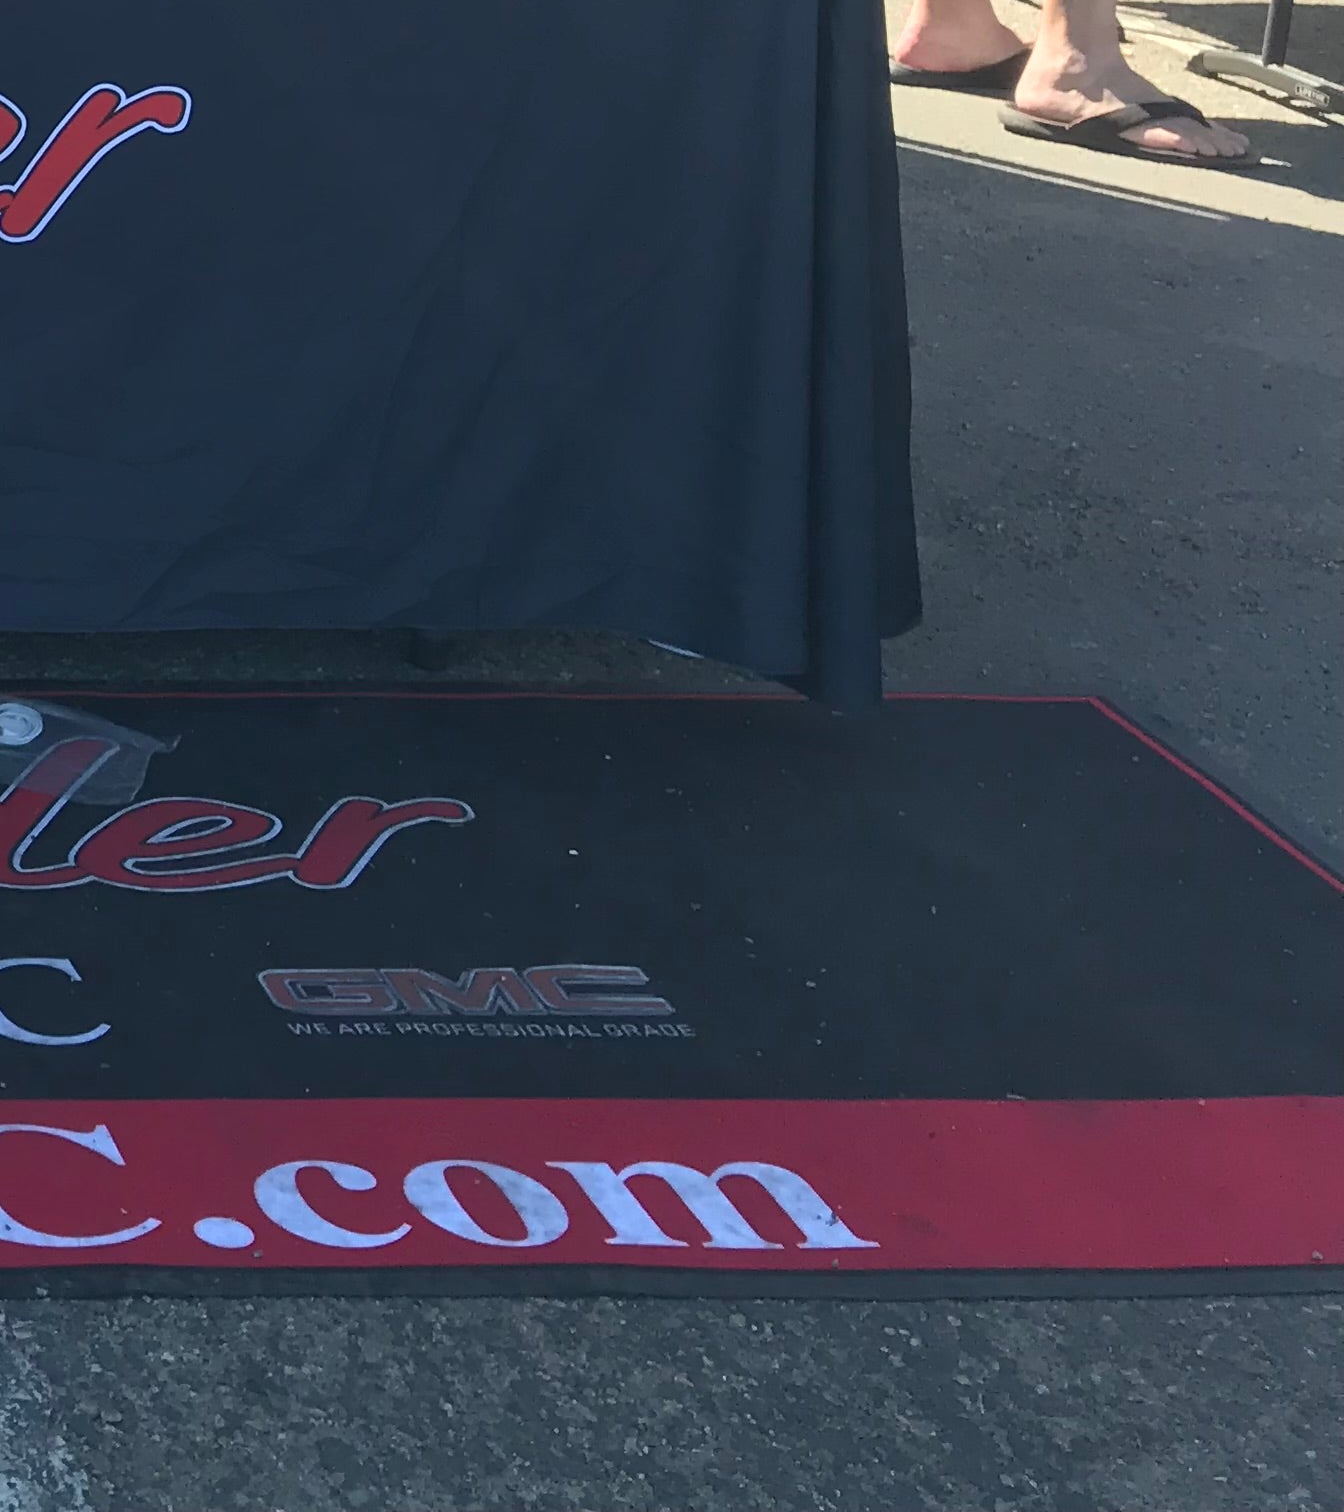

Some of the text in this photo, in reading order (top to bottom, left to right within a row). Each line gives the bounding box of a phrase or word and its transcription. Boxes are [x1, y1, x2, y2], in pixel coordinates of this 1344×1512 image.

[258, 964, 676, 1016] GMC
[287, 1022, 696, 1038] WE ARE PROFESSIONAL GRADE
